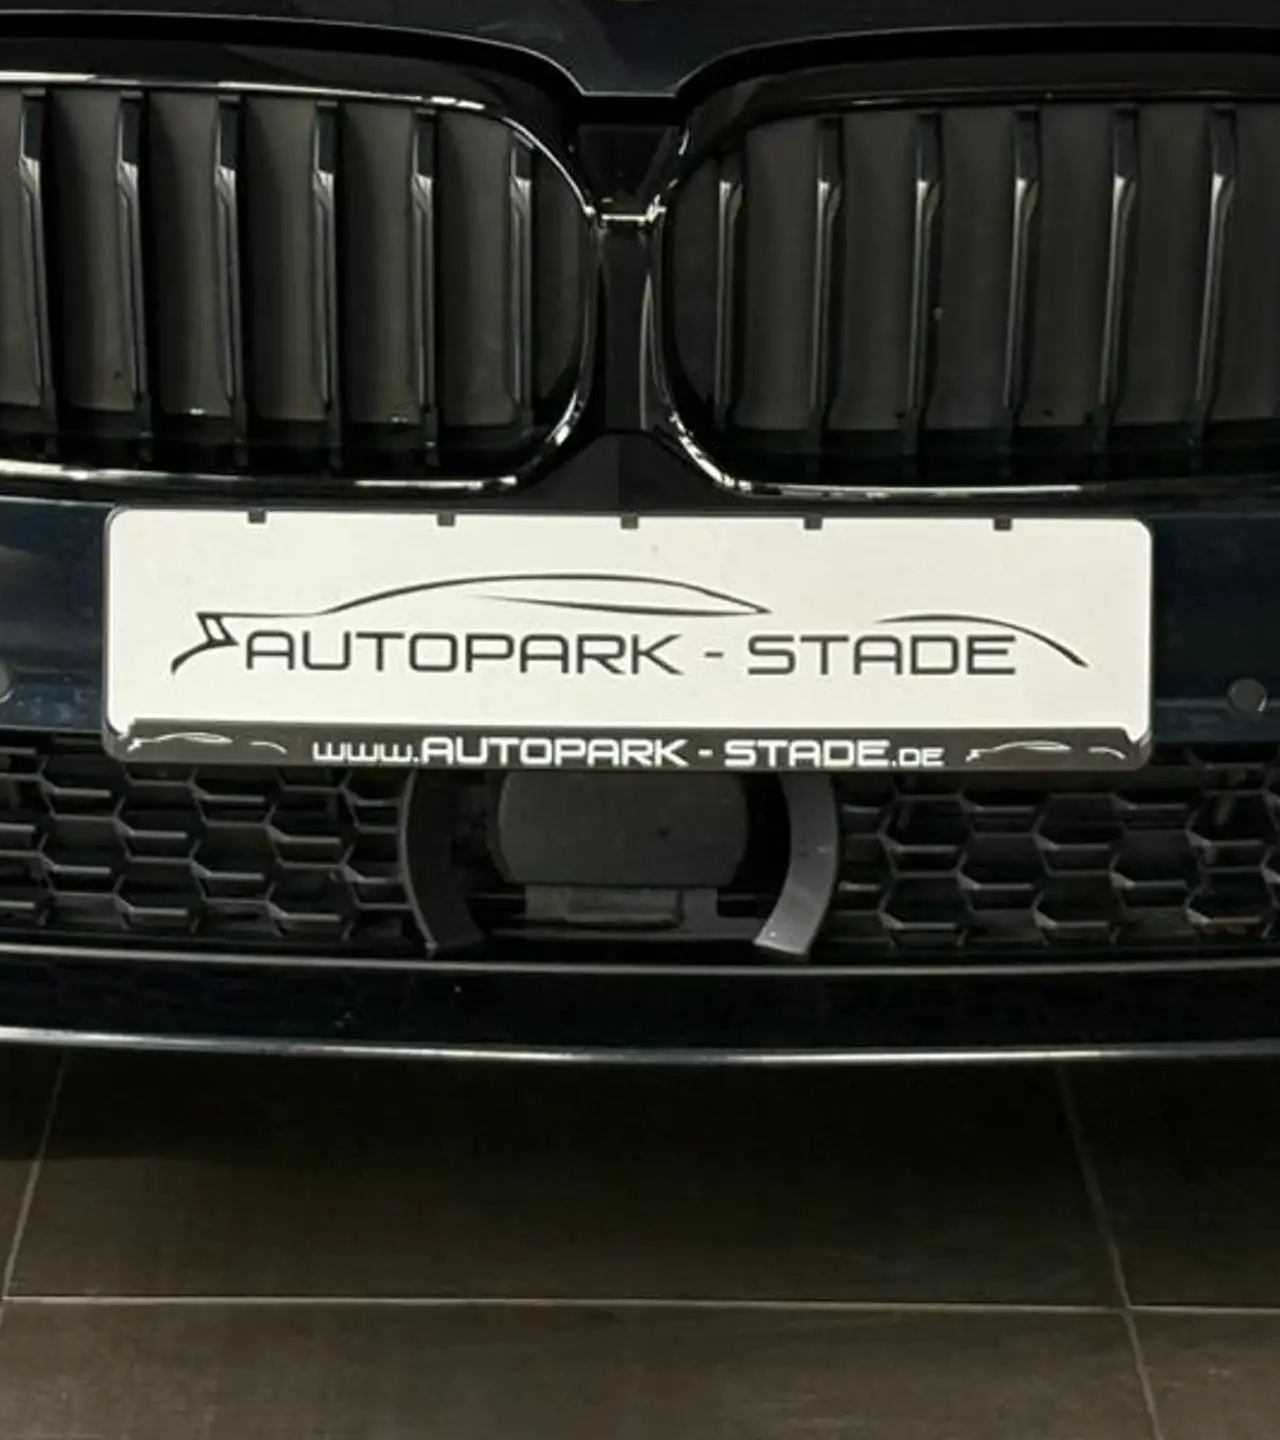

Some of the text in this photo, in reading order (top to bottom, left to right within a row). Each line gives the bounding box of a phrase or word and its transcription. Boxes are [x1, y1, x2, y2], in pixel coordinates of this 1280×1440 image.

[245, 630, 684, 675] AUTOPARK
[747, 634, 1017, 676] STADE
[312, 736, 688, 767] www.AUTOPARK
